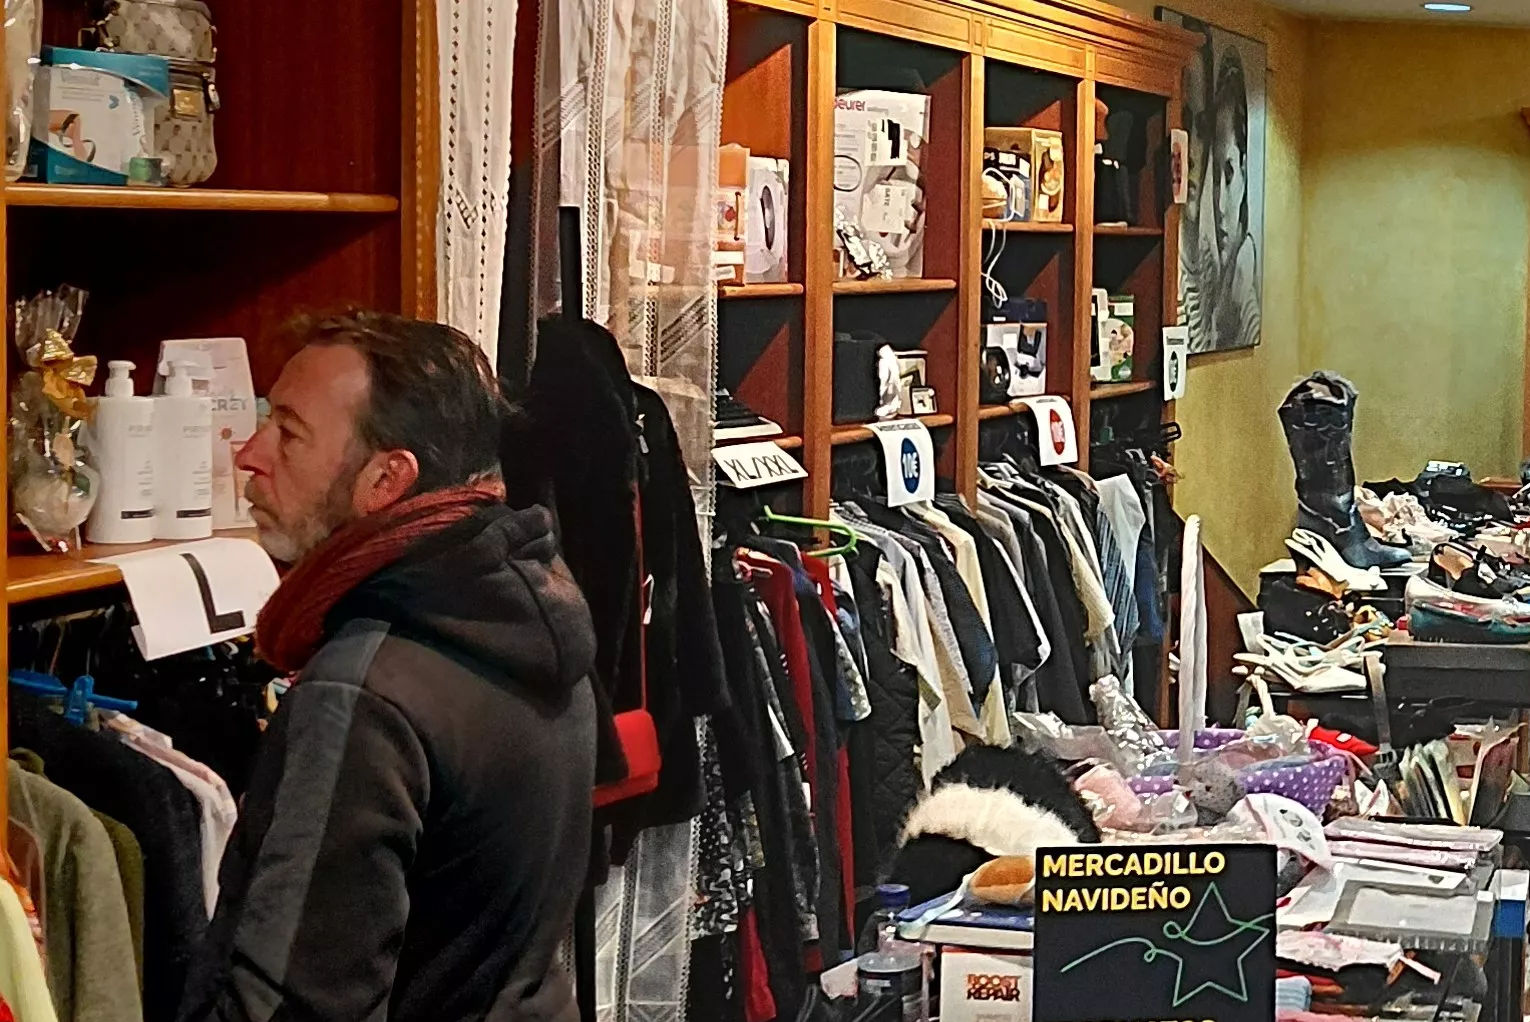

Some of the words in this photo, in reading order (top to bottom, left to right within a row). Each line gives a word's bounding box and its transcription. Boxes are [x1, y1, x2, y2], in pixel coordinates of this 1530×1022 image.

[723, 454, 799, 482] XL/XXL
[179, 553, 245, 634] L
[1042, 851, 1226, 878] MERCADILLO
[1042, 880, 1191, 912] NAVIDEÑO
[966, 986, 1021, 1002] REPAIR
[967, 973, 1022, 989] BOOST
